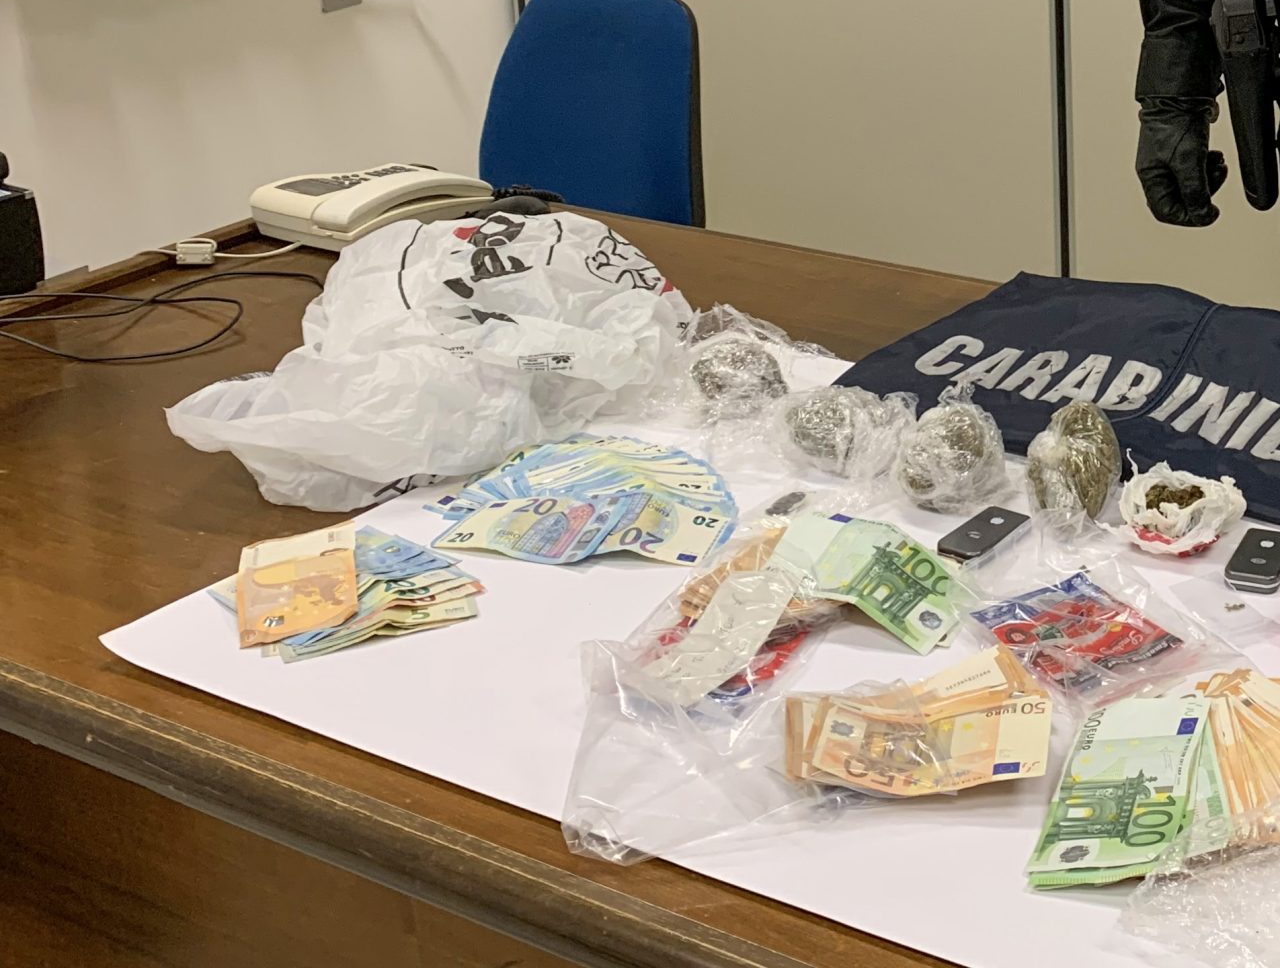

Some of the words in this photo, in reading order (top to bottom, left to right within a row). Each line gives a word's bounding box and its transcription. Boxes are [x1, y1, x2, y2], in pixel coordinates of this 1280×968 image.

[512, 497, 559, 516] 20
[692, 515, 720, 529] 20
[446, 532, 475, 543] 20
[619, 526, 665, 555] 20
[985, 703, 1017, 718] EURO
[1020, 701, 1046, 715] 50
[1081, 728, 1097, 751] EURO
[1123, 794, 1177, 848] 100
